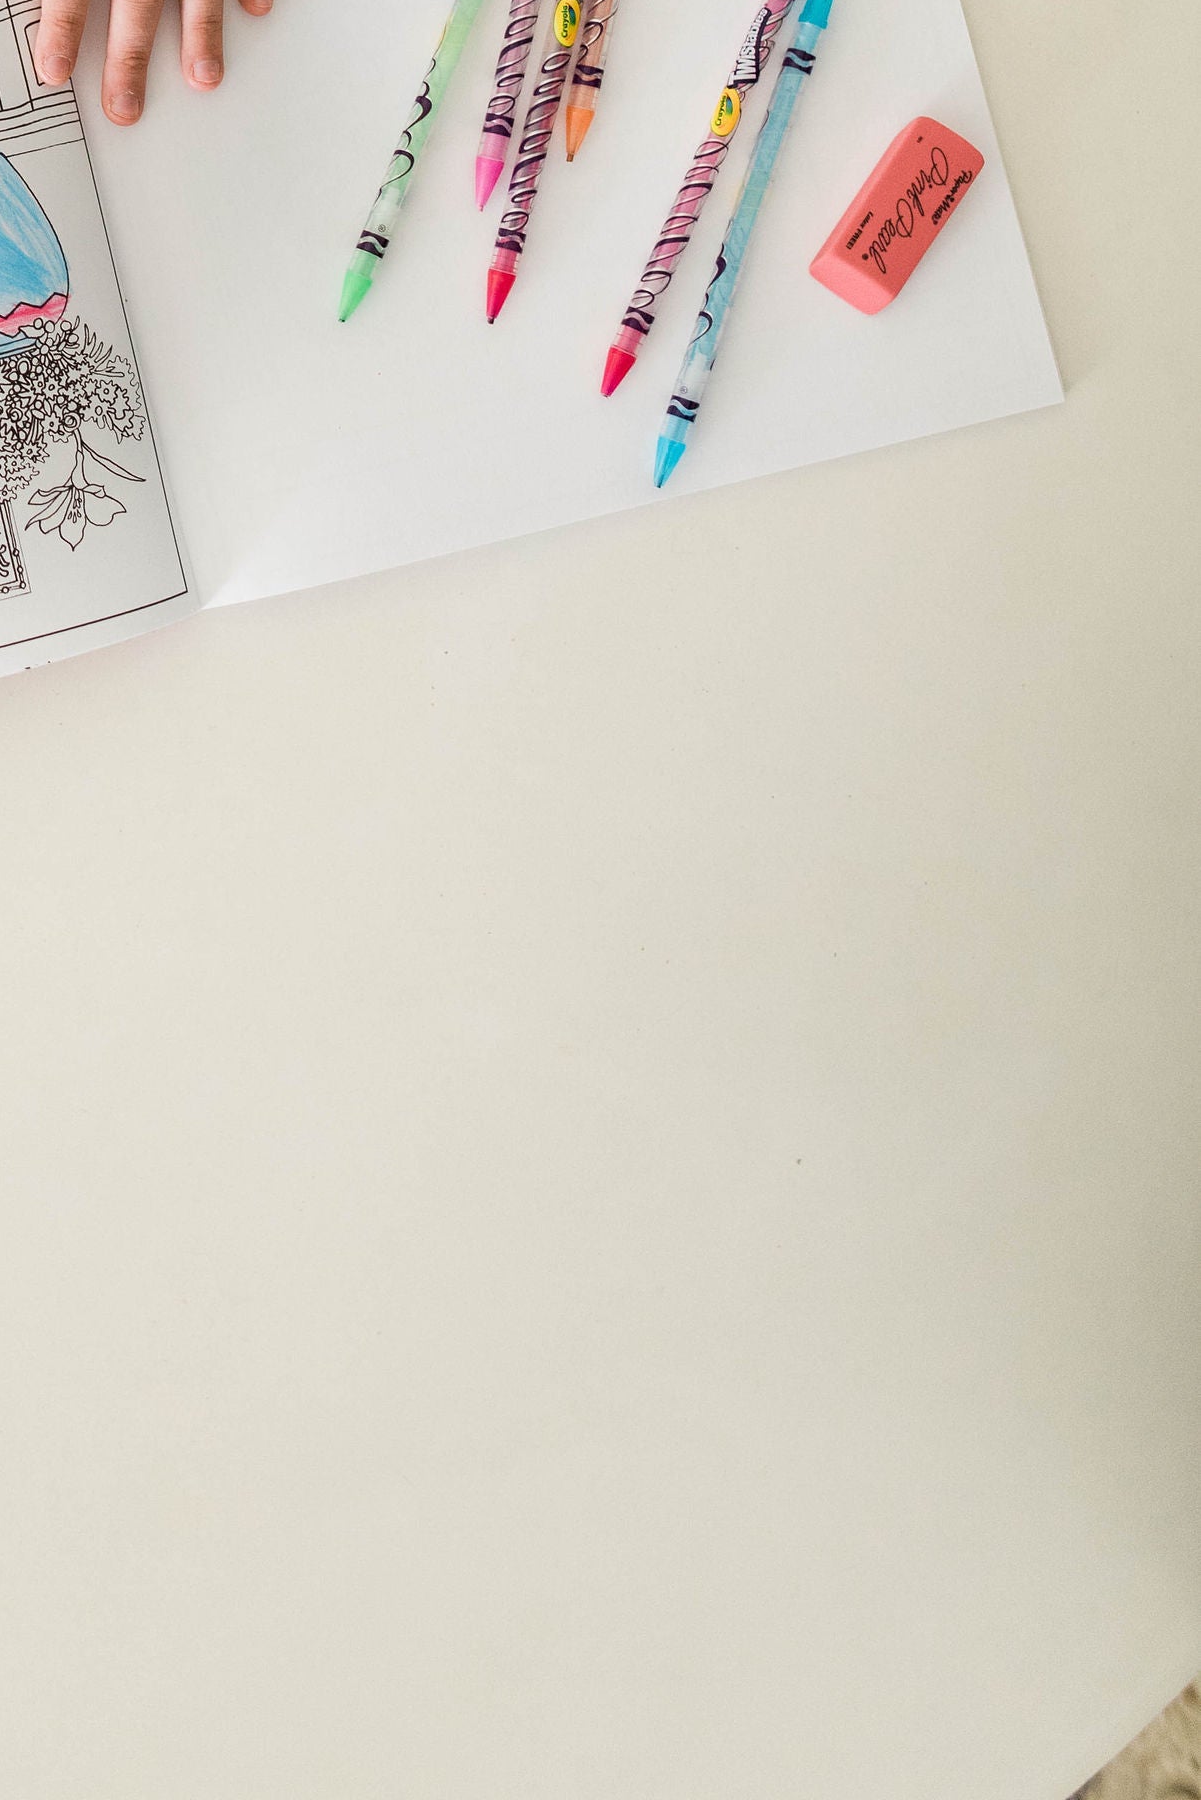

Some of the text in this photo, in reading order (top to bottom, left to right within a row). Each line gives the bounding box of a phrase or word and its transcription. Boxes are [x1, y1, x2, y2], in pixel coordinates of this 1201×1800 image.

[560, 4, 570, 39] Crayola
[726, 6, 769, 86] Twistables
[906, 146, 949, 217] Pink
